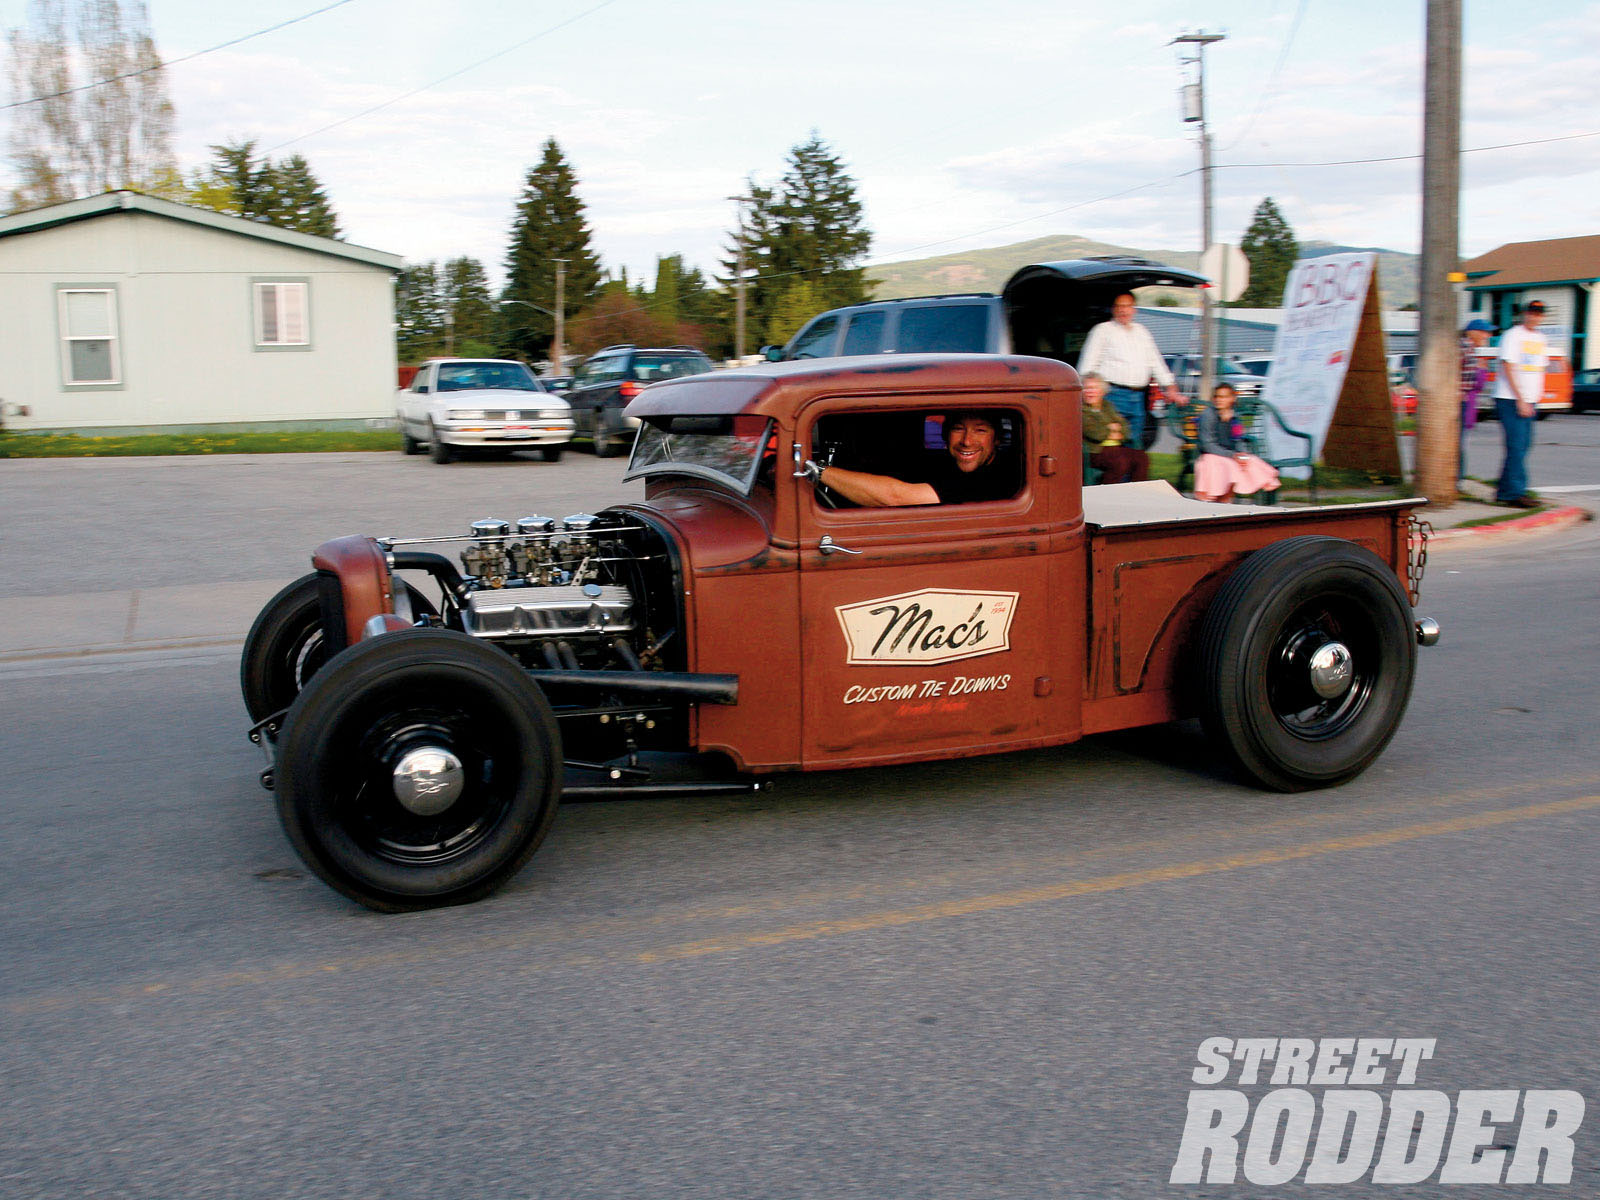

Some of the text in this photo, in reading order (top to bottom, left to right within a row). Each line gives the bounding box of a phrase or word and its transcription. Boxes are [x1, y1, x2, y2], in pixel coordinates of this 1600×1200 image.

[869, 601, 989, 656] Mac's
[843, 674, 1011, 704] CUSTOM TIE DOWNS
